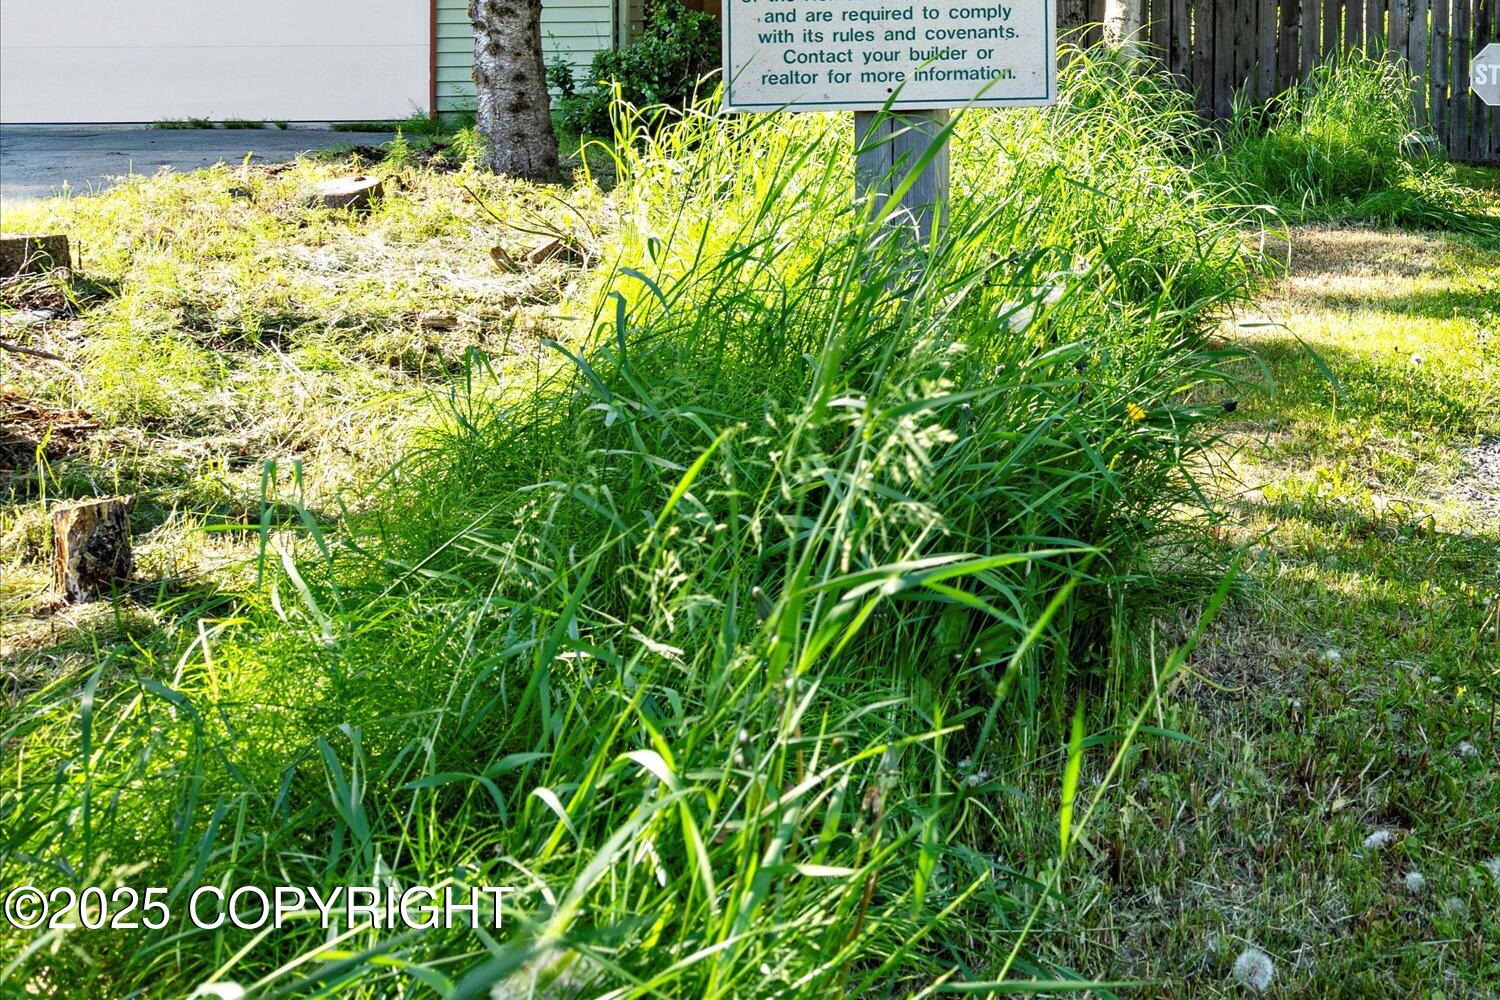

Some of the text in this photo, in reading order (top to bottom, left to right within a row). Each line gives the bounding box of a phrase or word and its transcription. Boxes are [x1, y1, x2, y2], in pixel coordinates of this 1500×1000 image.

[765, 4, 1012, 24] and are required to comply
[758, 25, 1020, 44] with its rules and covenants.
[783, 46, 995, 66] Contact your builder or
[761, 65, 1016, 86] realtor for more information.
